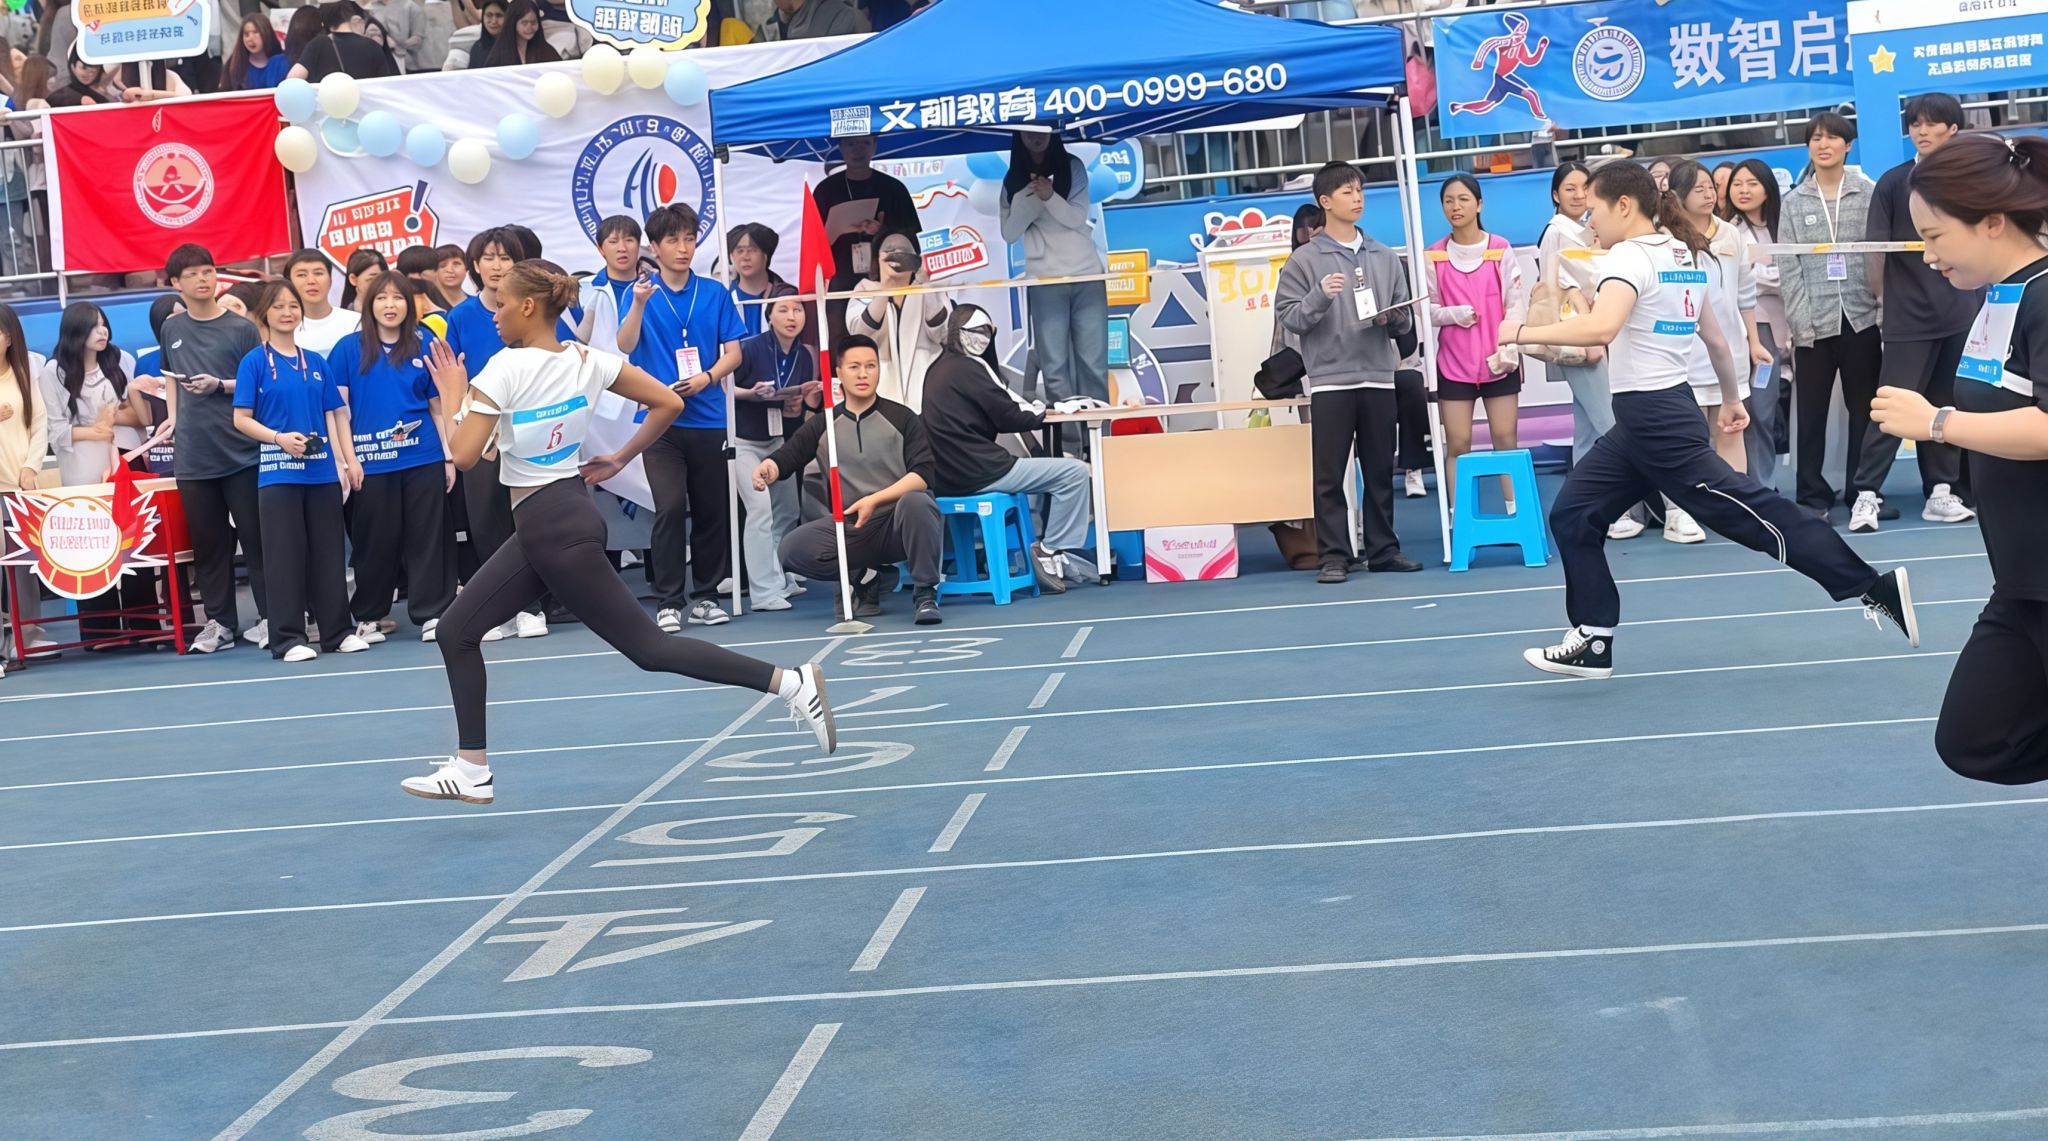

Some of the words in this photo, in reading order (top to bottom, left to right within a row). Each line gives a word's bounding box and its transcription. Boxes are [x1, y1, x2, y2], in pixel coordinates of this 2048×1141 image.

[1669, 11, 1853, 89] 数智启
[1043, 63, 1287, 115] 400-0999-680
[591, 812, 858, 868] 5
[484, 906, 774, 982] 4
[302, 1045, 654, 1141] 3
